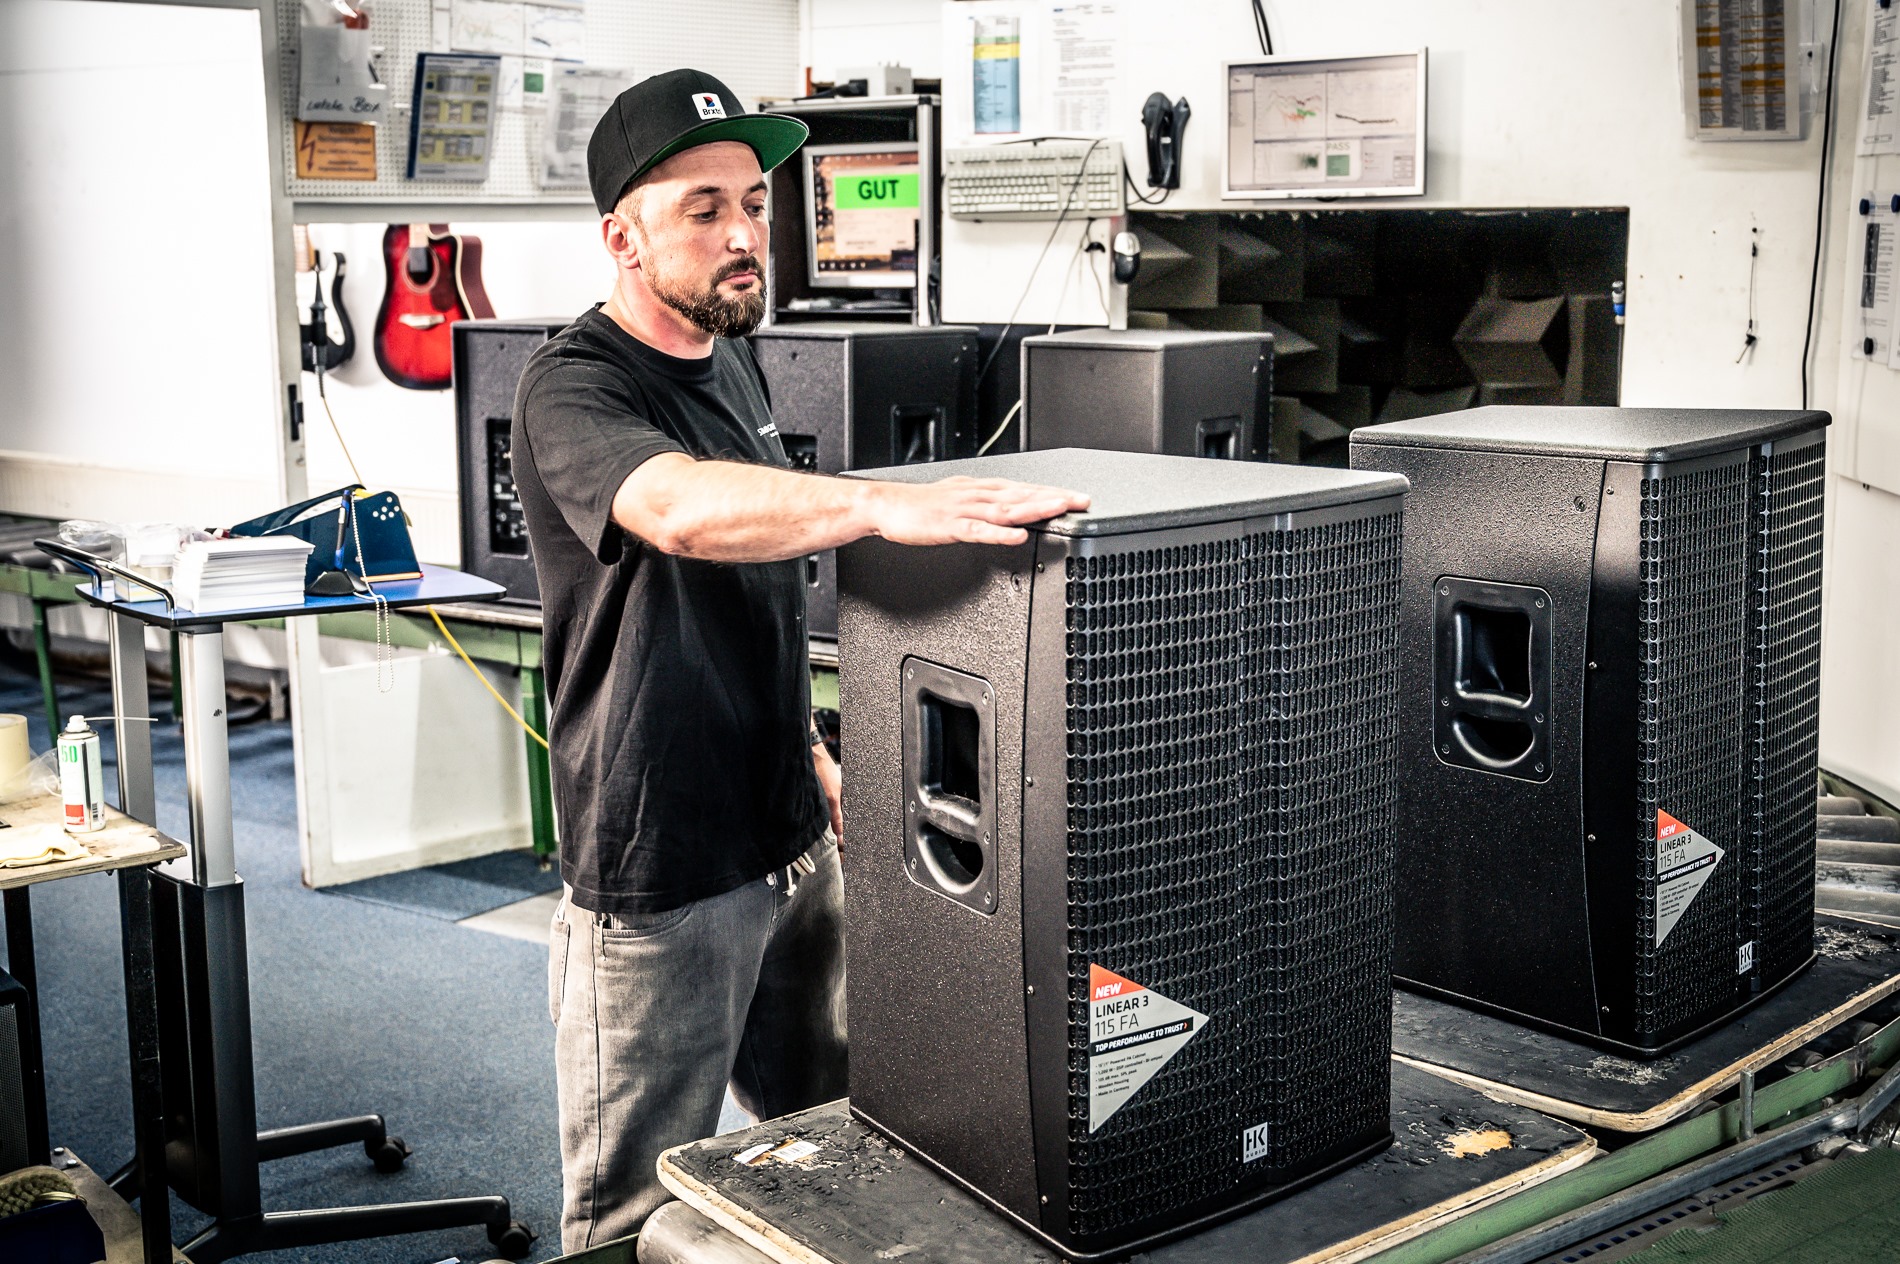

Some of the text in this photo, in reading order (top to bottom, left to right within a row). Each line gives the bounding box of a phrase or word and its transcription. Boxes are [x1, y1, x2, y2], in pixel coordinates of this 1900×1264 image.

[349, 96, 380, 113] Box
[858, 180, 899, 200] GUT
[1660, 824, 1676, 837] NEW
[1661, 834, 1692, 853] LINEAR 3
[1660, 849, 1686, 869] 115 FA
[1660, 873, 1668, 882] TOP
[1667, 863, 1695, 879] PERFORMANCE
[1700, 857, 1710, 866] TRUST
[1741, 945, 1751, 966] HK
[1095, 982, 1122, 999] NEW
[1096, 995, 1149, 1018] LINEAR 3
[1095, 1013, 1139, 1036] 115 FA
[1095, 1023, 1184, 1052] TOP PERFORMANCE TO TRUST
[1246, 1127, 1265, 1151] HK
